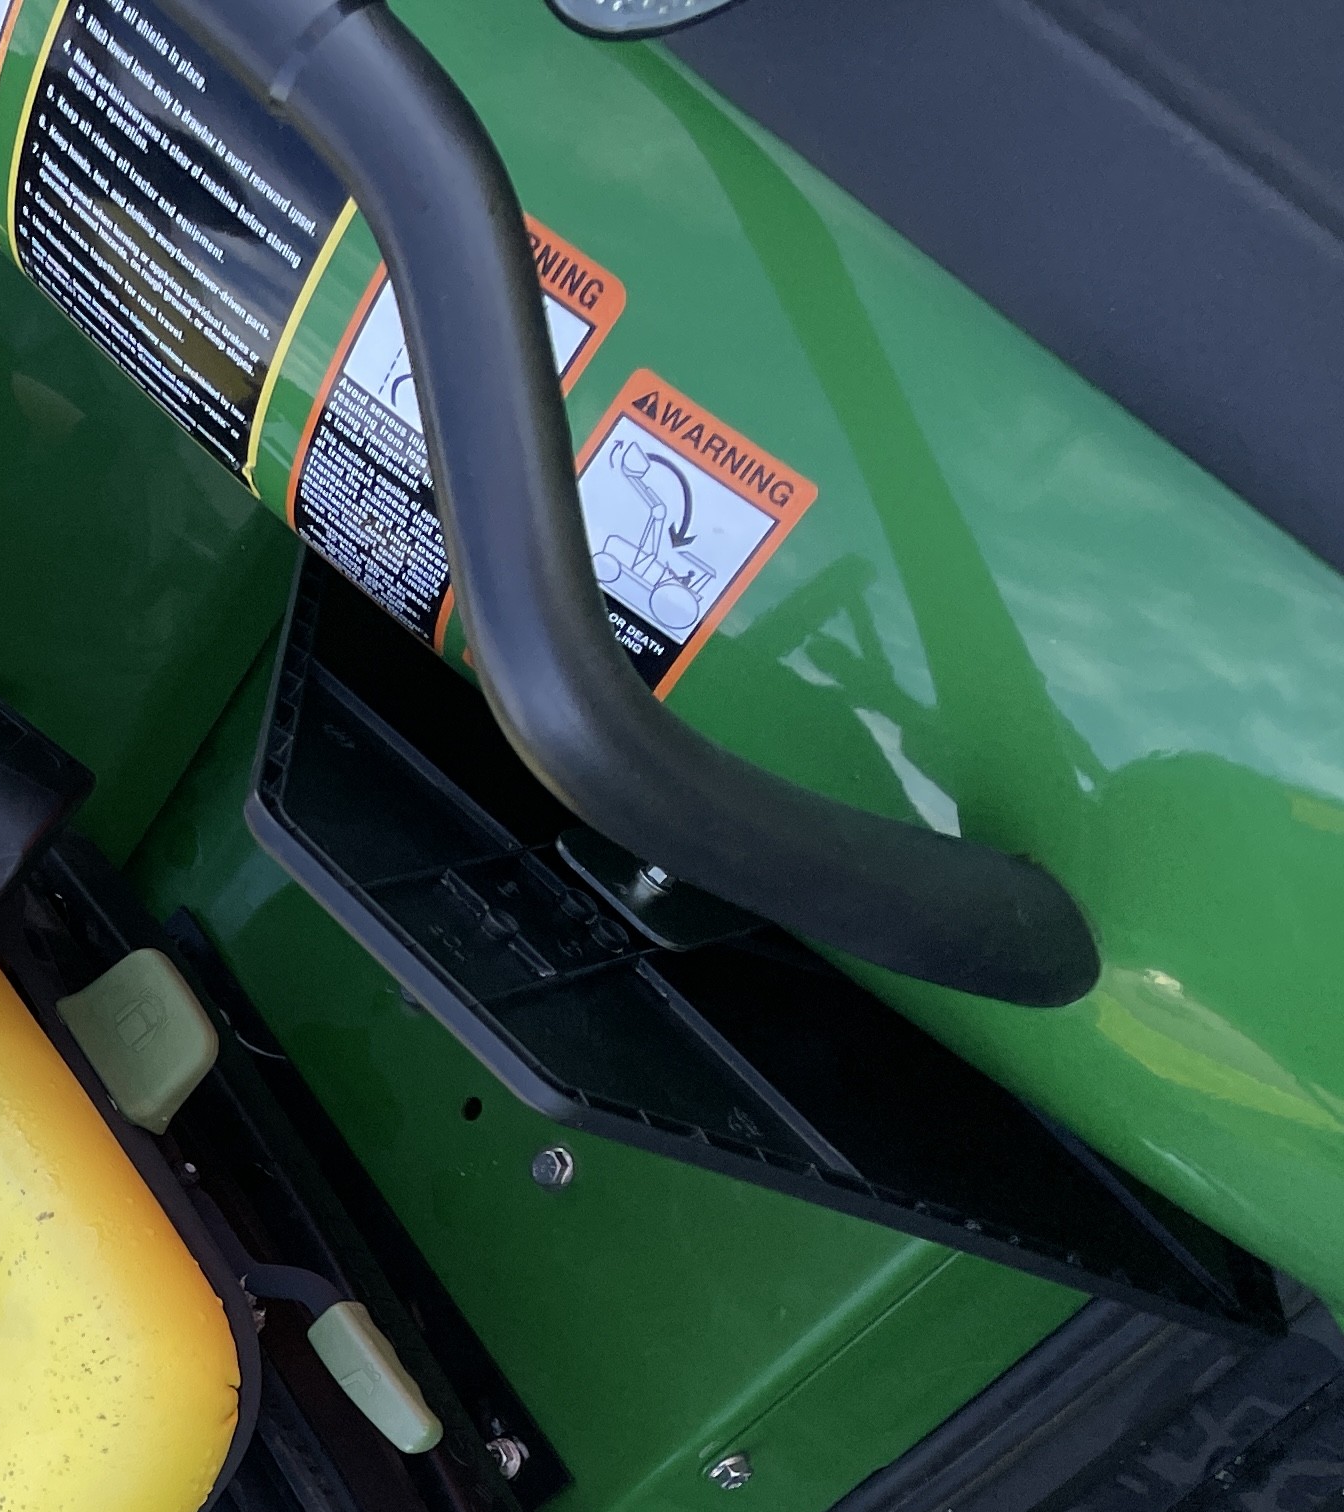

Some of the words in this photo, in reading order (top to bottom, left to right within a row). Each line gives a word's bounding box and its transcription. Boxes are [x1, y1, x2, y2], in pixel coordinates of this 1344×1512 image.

[123, 6, 139, 25] all
[136, 18, 169, 56] shields
[168, 46, 179, 66] in
[63, 39, 71, 56] 4.
[73, 48, 96, 79] Make
[95, 73, 125, 108] certain
[123, 101, 166, 142] everyone
[160, 133, 170, 150] is
[169, 144, 192, 170] clear
[191, 165, 203, 179] of
[200, 173, 238, 213] machine
[237, 204, 267, 238] before
[266, 232, 301, 269] starting
[67, 67, 96, 101] engine
[96, 95, 107, 110] or
[106, 106, 148, 154] operation.
[76, 4, 85, 23] 3.
[86, 14, 112, 45] Hitch
[107, 36, 134, 69] towed
[131, 59, 155, 91] loads
[154, 85, 173, 109] only
[172, 99, 185, 118] to
[181, 110, 217, 148] drawbar
[215, 140, 226, 157] to
[224, 151, 252, 179] avoid
[249, 172, 291, 213] rearward
[288, 206, 316, 237] upset.
[57, 95, 79, 124] Keep
[78, 119, 92, 137] all
[91, 132, 117, 162] riders
[116, 156, 130, 174] off
[129, 166, 159, 201] tractor
[158, 196, 177, 218] and
[175, 213, 224, 264] equipment.
[48, 124, 68, 151] Keep
[110, 188, 127, 210] and
[156, 232, 180, 259] away
[176, 248, 196, 278] from
[193, 268, 246, 319] power-driven
[245, 314, 270, 340] parts.
[140, 252, 150, 264] or
[149, 261, 184, 299] applying
[182, 289, 222, 331] individual
[221, 324, 250, 355] brakes
[249, 350, 260, 363] or
[329, 401, 361, 432] during
[362, 426, 408, 468] transport
[408, 461, 421, 483] or
[334, 390, 378, 431] resulting
[379, 425, 404, 450] from
[405, 445, 427, 468] loss
[338, 377, 369, 406] Avoid
[369, 403, 407, 437] serious
[312, 447, 344, 477] exceed
[345, 473, 360, 490] the
[362, 488, 407, 528] maximum
[315, 437, 326, 450] at
[328, 446, 373, 488] transport
[374, 485, 410, 518] speeds
[412, 514, 433, 536] that
[320, 425, 337, 446] This
[338, 442, 366, 469] tractor
[366, 464, 375, 477] is
[376, 474, 409, 504] capable
[410, 501, 421, 517] of
[324, 411, 332, 422] a
[334, 417, 365, 447] towed
[365, 442, 420, 493] implement.
[660, 401, 795, 507] WARNING
[308, 455, 358, 500] transport
[360, 498, 393, 532] speed
[396, 526, 412, 547] for
[414, 541, 449, 572] towed
[386, 529, 446, 581] implement
[389, 544, 405, 560] not
[608, 612, 627, 629] OR
[626, 625, 665, 656] DEATH
